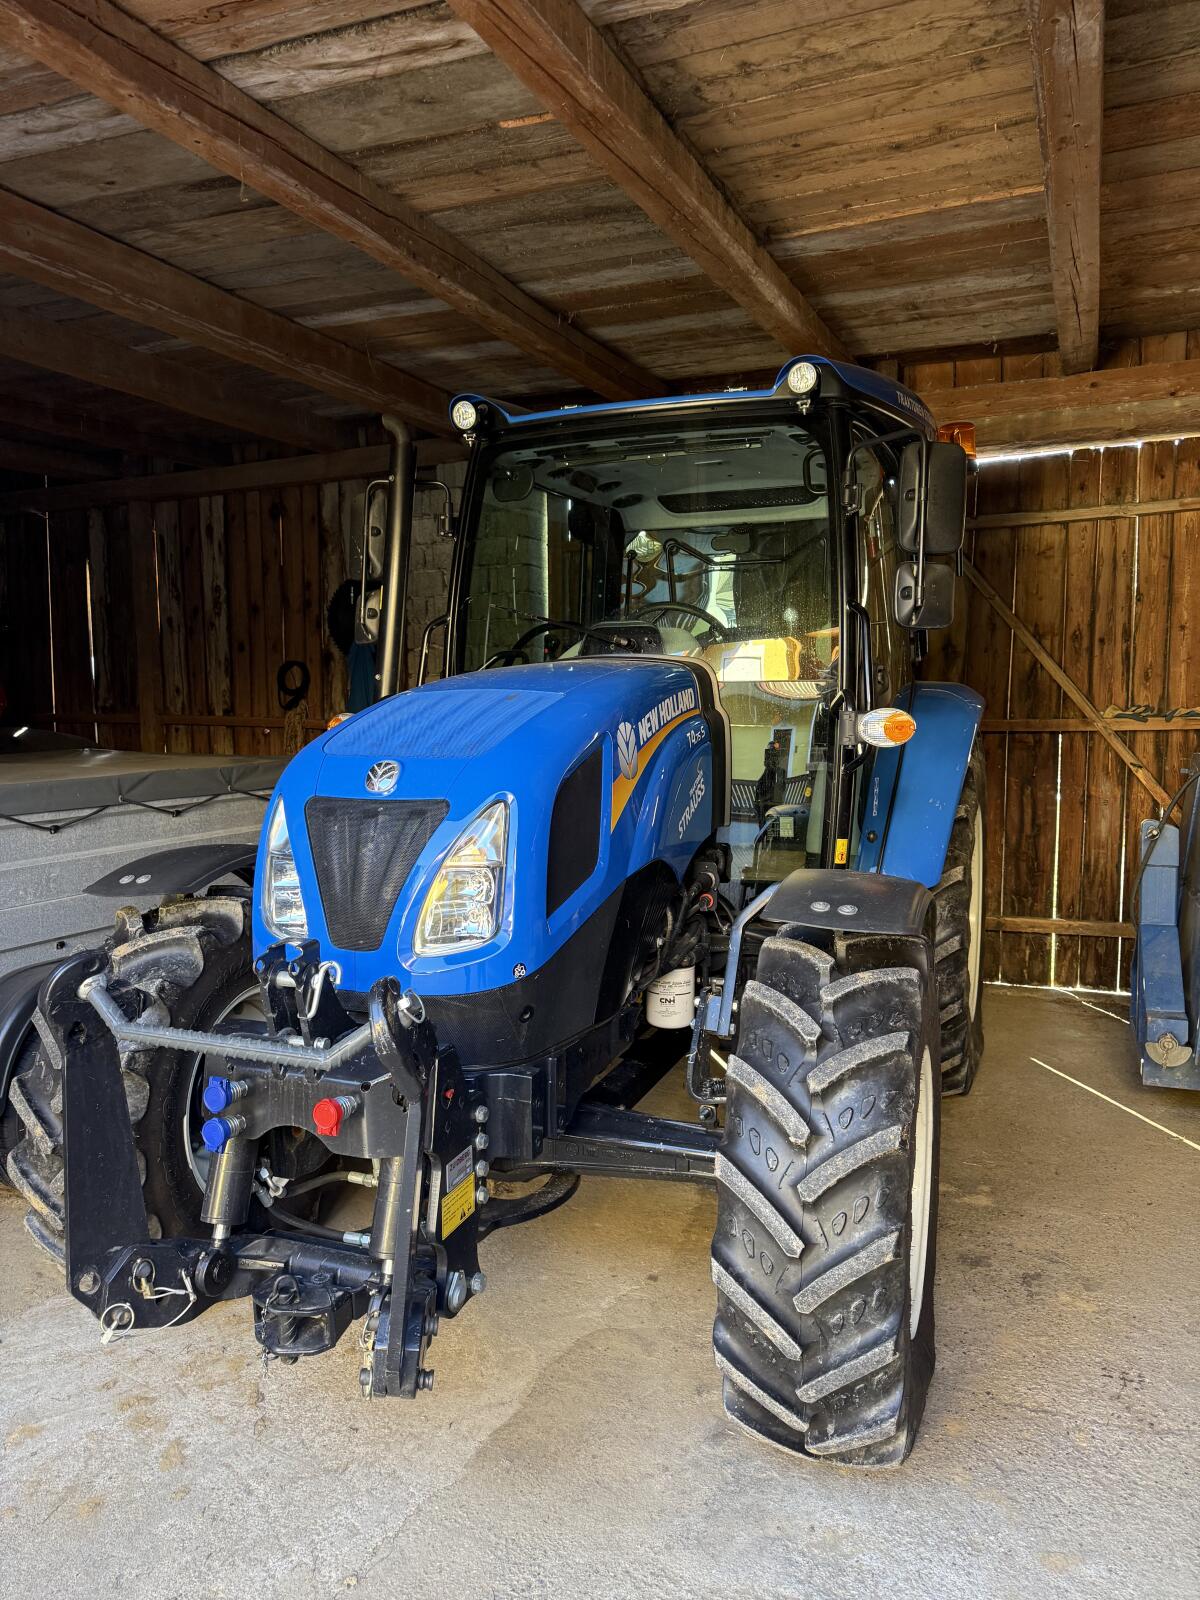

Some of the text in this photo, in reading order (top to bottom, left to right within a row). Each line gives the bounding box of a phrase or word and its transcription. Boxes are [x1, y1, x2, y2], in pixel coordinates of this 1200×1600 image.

[638, 688, 695, 746] NEW HOLLAND
[678, 777, 706, 840] STRAUSS
